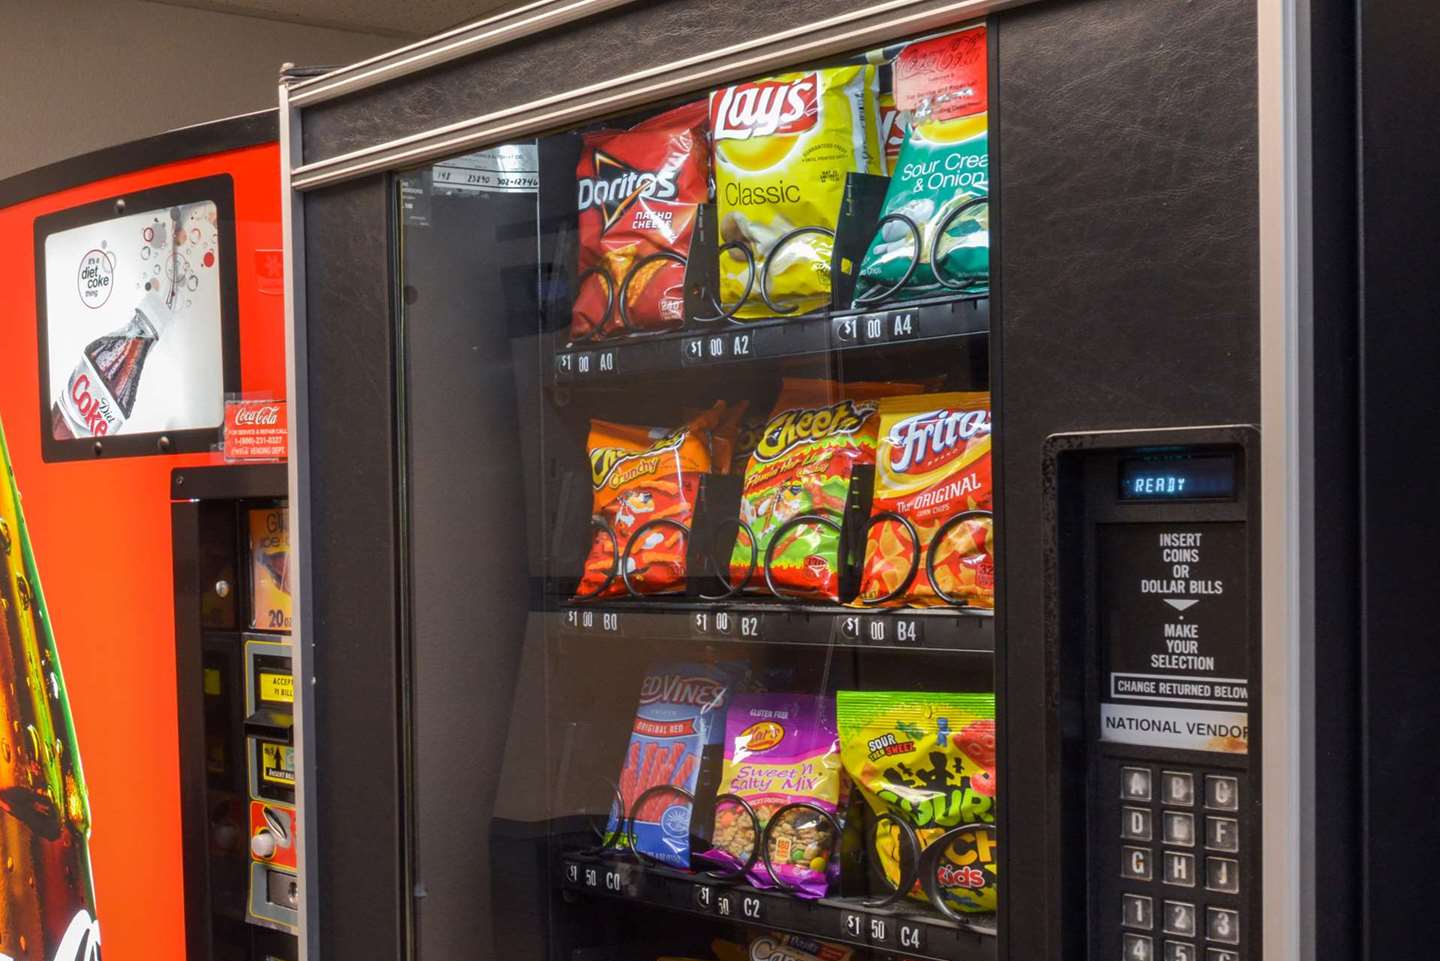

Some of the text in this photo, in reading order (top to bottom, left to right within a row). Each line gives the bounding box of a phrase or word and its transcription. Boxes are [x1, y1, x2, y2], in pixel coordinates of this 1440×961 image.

[715, 79, 814, 139] Lay's
[902, 153, 989, 181] Sour Crea
[578, 170, 677, 211] Doritos
[725, 180, 801, 206] Classic
[913, 172, 985, 193] & Onion
[81, 265, 98, 280] diet
[87, 274, 109, 288] coke
[844, 314, 912, 338] $1 00 A4
[691, 335, 749, 357] $1 00 A2
[562, 353, 613, 373] $1 00 A0
[72, 374, 108, 436] Coke
[235, 406, 280, 426] Coca-Cola
[888, 409, 991, 473] Frito
[610, 457, 659, 488] Crunchy
[914, 473, 982, 509] ORIGINAL
[1135, 477, 1186, 493] READY
[1159, 533, 1202, 547] INSERT
[1163, 549, 1199, 563] COINS
[1173, 564, 1189, 579] OR
[1141, 580, 1223, 595] DOLLAR BILLS
[269, 610, 283, 628] 20
[568, 611, 577, 627] $1
[583, 612, 593, 627] 00
[696, 612, 758, 636] $1 00 B2
[847, 617, 916, 641] $1 00 B4
[1164, 624, 1199, 638] MAKE
[1166, 640, 1198, 654] YOUR
[1151, 654, 1214, 671] SELECTION
[1118, 679, 1248, 699] CHANGE RETURNED BELOW
[750, 709, 789, 719] GLUTEN FREE
[1105, 715, 1181, 734] NATIONAL
[637, 721, 684, 734] ORIGINAL RED
[868, 733, 896, 752] SOUR
[737, 766, 799, 781] Sweet
[1130, 772, 1143, 796] A
[730, 778, 772, 792] Salty
[1172, 778, 1185, 799] B
[1132, 812, 1143, 833] D
[1216, 821, 1226, 842] F
[1132, 852, 1144, 874] G
[1174, 857, 1186, 879] H
[1219, 862, 1227, 884] J
[570, 864, 620, 891] $1 50 C0
[701, 887, 709, 904] $1
[744, 897, 760, 917] C2
[1135, 900, 1143, 922] 1
[1175, 906, 1186, 928] 2
[1218, 913, 1229, 935] 3
[847, 915, 920, 949] $1 50 C4
[1133, 939, 1145, 960] 4
